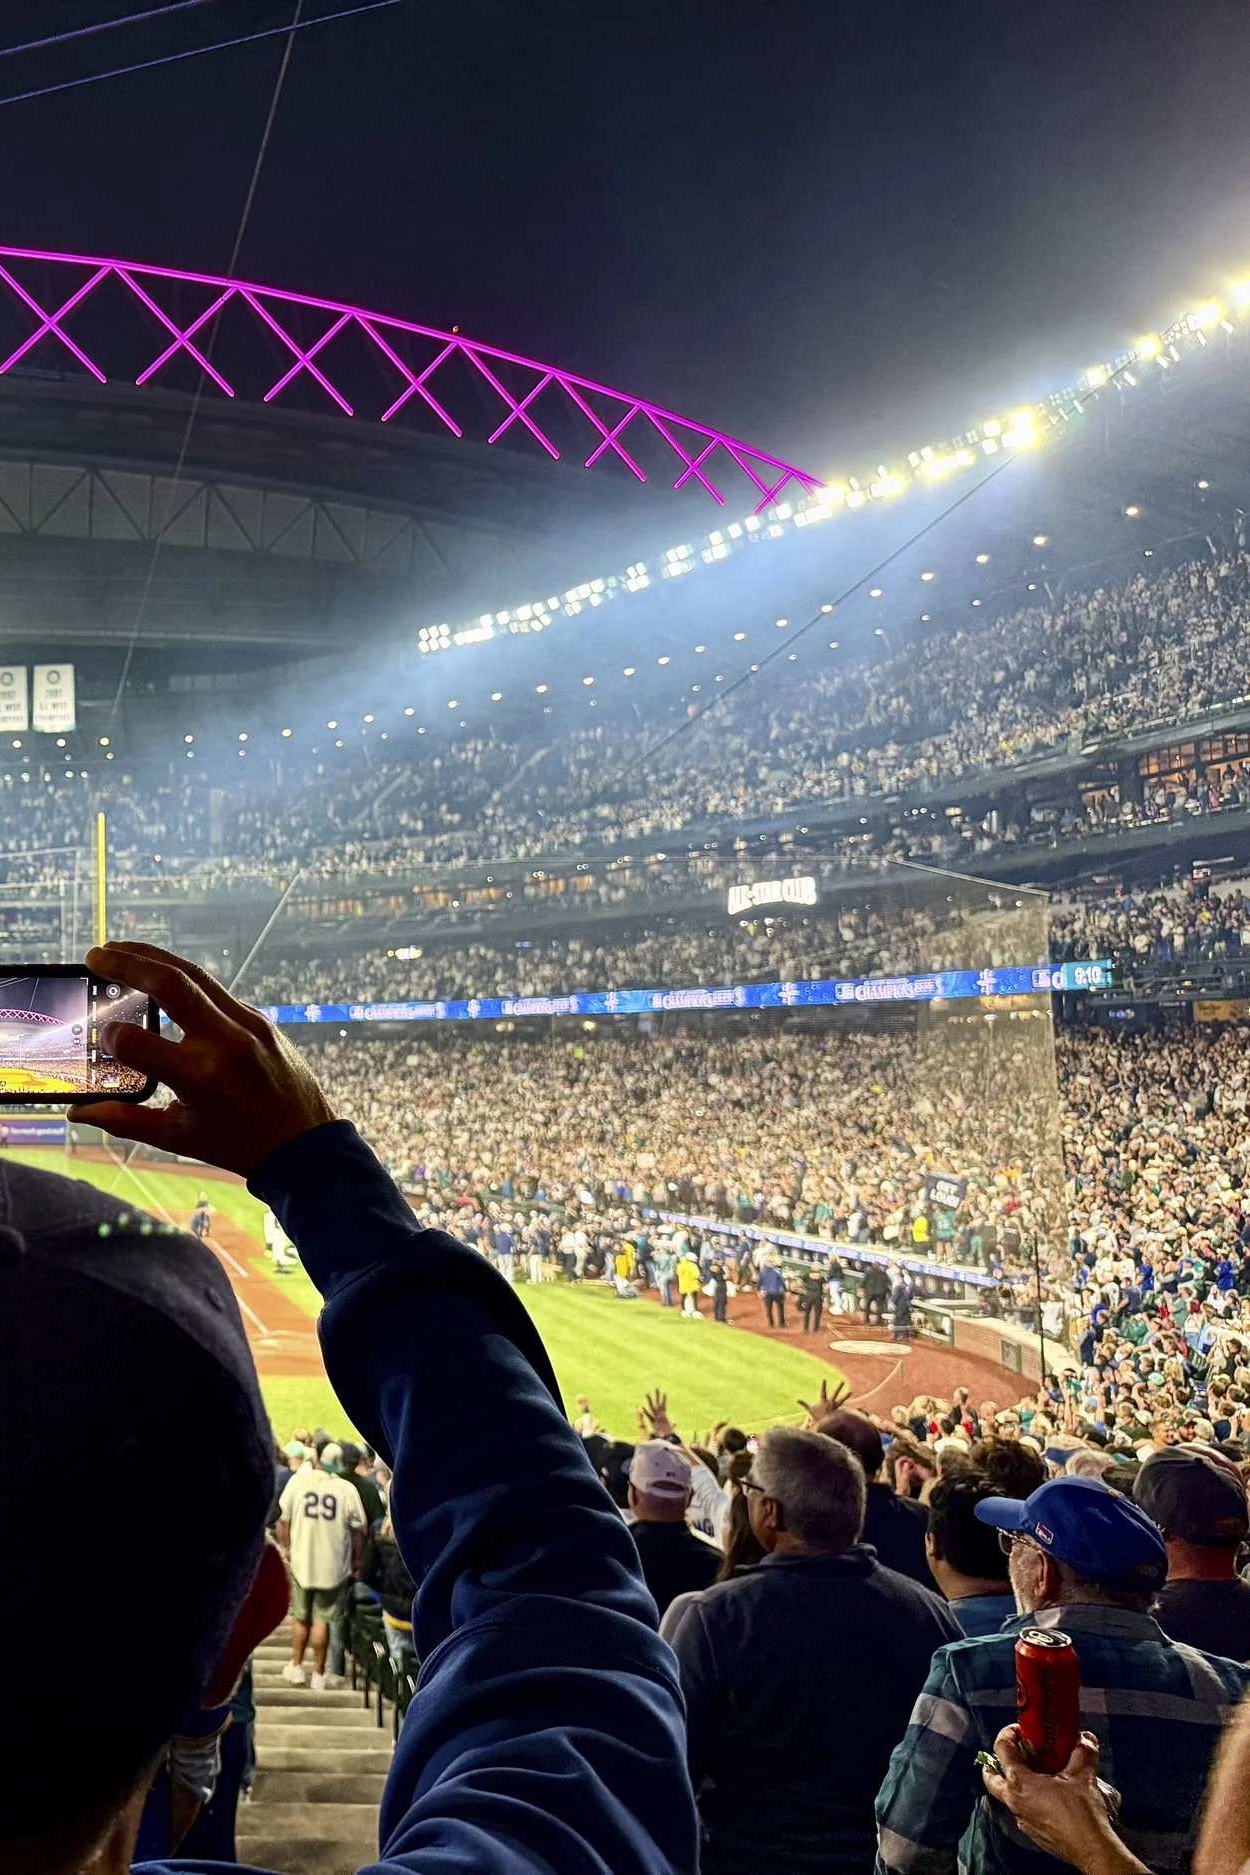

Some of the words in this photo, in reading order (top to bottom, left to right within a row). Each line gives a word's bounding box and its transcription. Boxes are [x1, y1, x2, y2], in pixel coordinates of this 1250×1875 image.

[728, 880, 783, 915] ALL-STAR
[781, 876, 817, 906] CLUB
[1074, 965, 1102, 985] 9:10
[855, 983, 915, 1001] CHAMPIONS
[304, 1491, 337, 1520] 29
